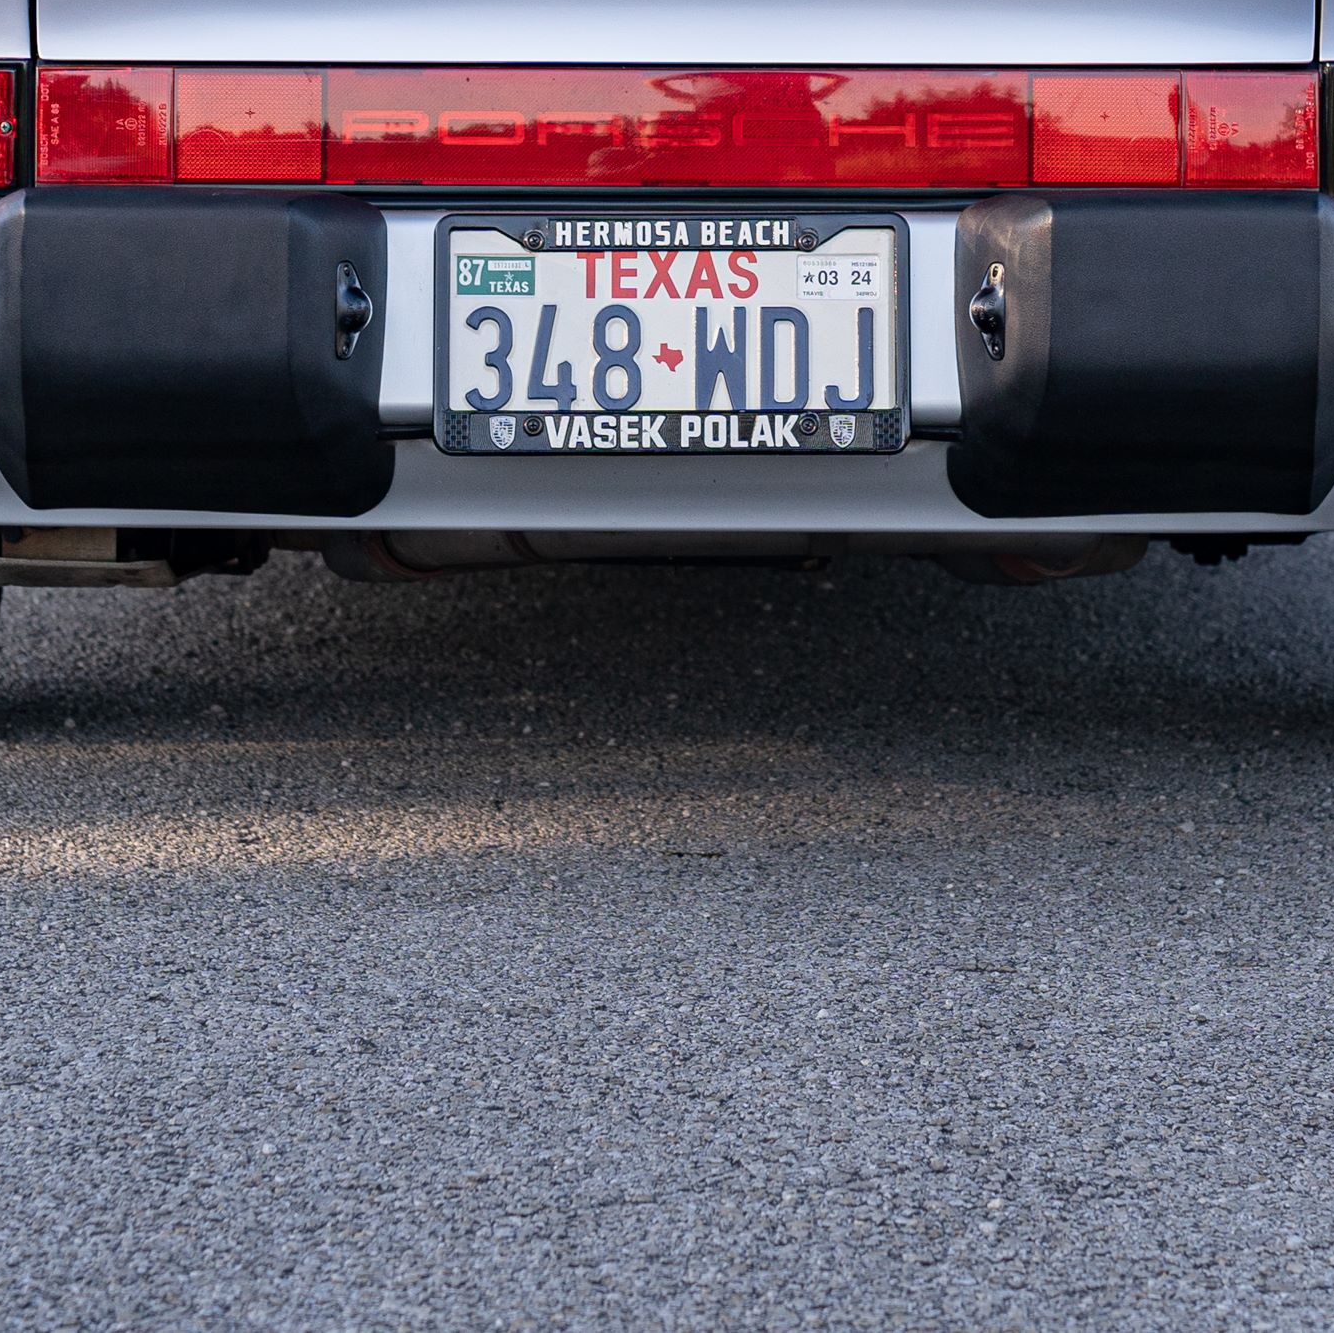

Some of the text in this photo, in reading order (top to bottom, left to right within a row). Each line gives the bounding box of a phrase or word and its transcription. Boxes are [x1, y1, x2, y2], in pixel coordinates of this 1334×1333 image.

[51, 126, 60, 145] SAE
[339, 108, 1016, 148] PORSCHE
[555, 220, 790, 248] HERMOSA BEACH
[459, 259, 485, 286] 87
[576, 251, 760, 299] TEXAS
[818, 270, 872, 285] 03 24
[489, 281, 529, 293] TEXAS
[465, 304, 874, 411] 348 WDJ
[543, 415, 800, 450] VASEK POLAK
